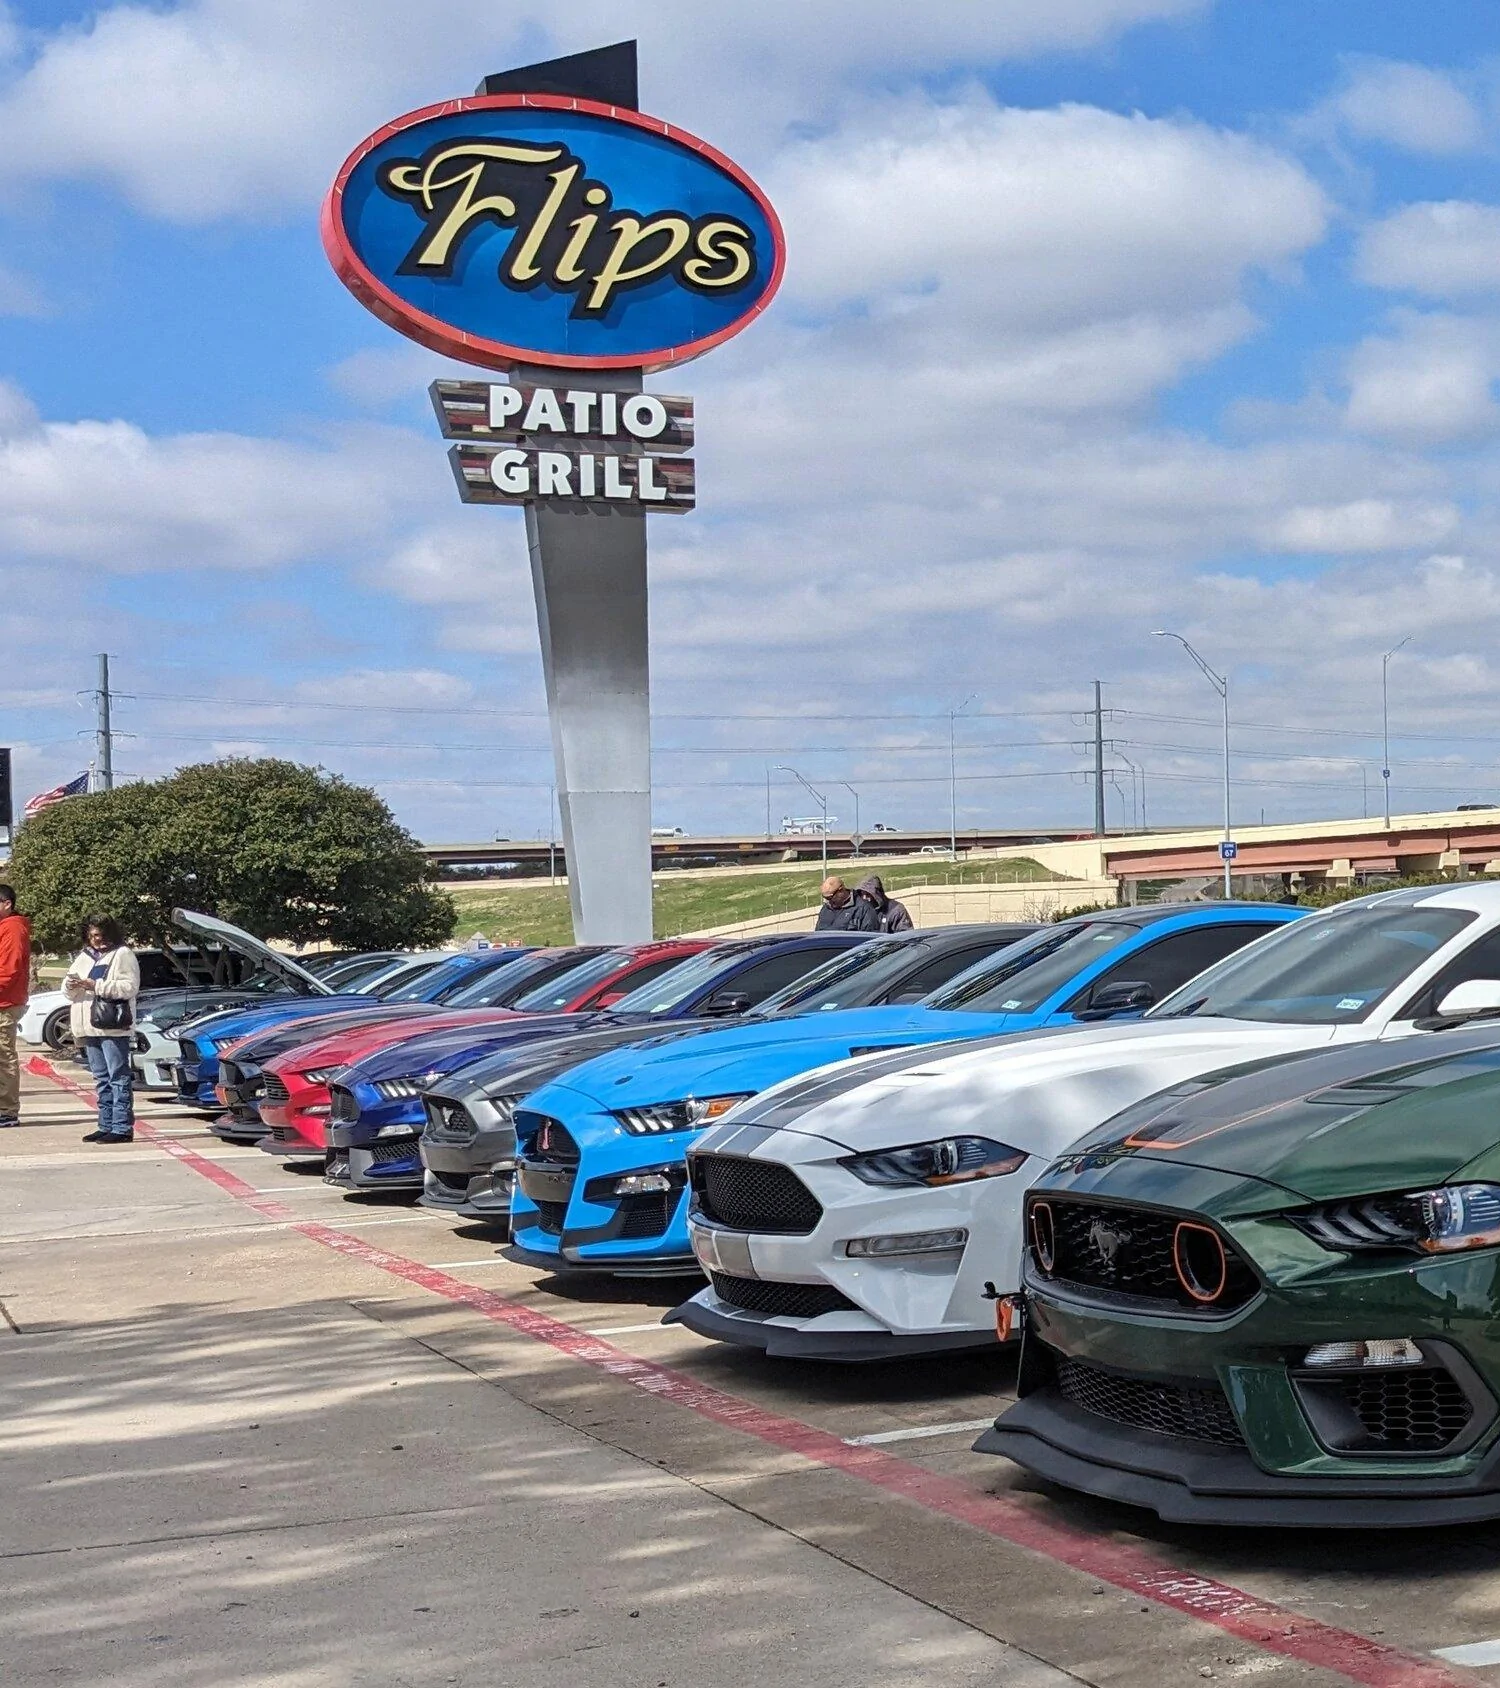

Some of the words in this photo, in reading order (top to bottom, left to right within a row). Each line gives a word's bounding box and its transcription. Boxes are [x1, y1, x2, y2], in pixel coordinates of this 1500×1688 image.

[388, 143, 752, 309] Flips
[489, 385, 668, 439] PATIO
[490, 449, 668, 500] GRILL
[1225, 849, 1234, 857] 67
